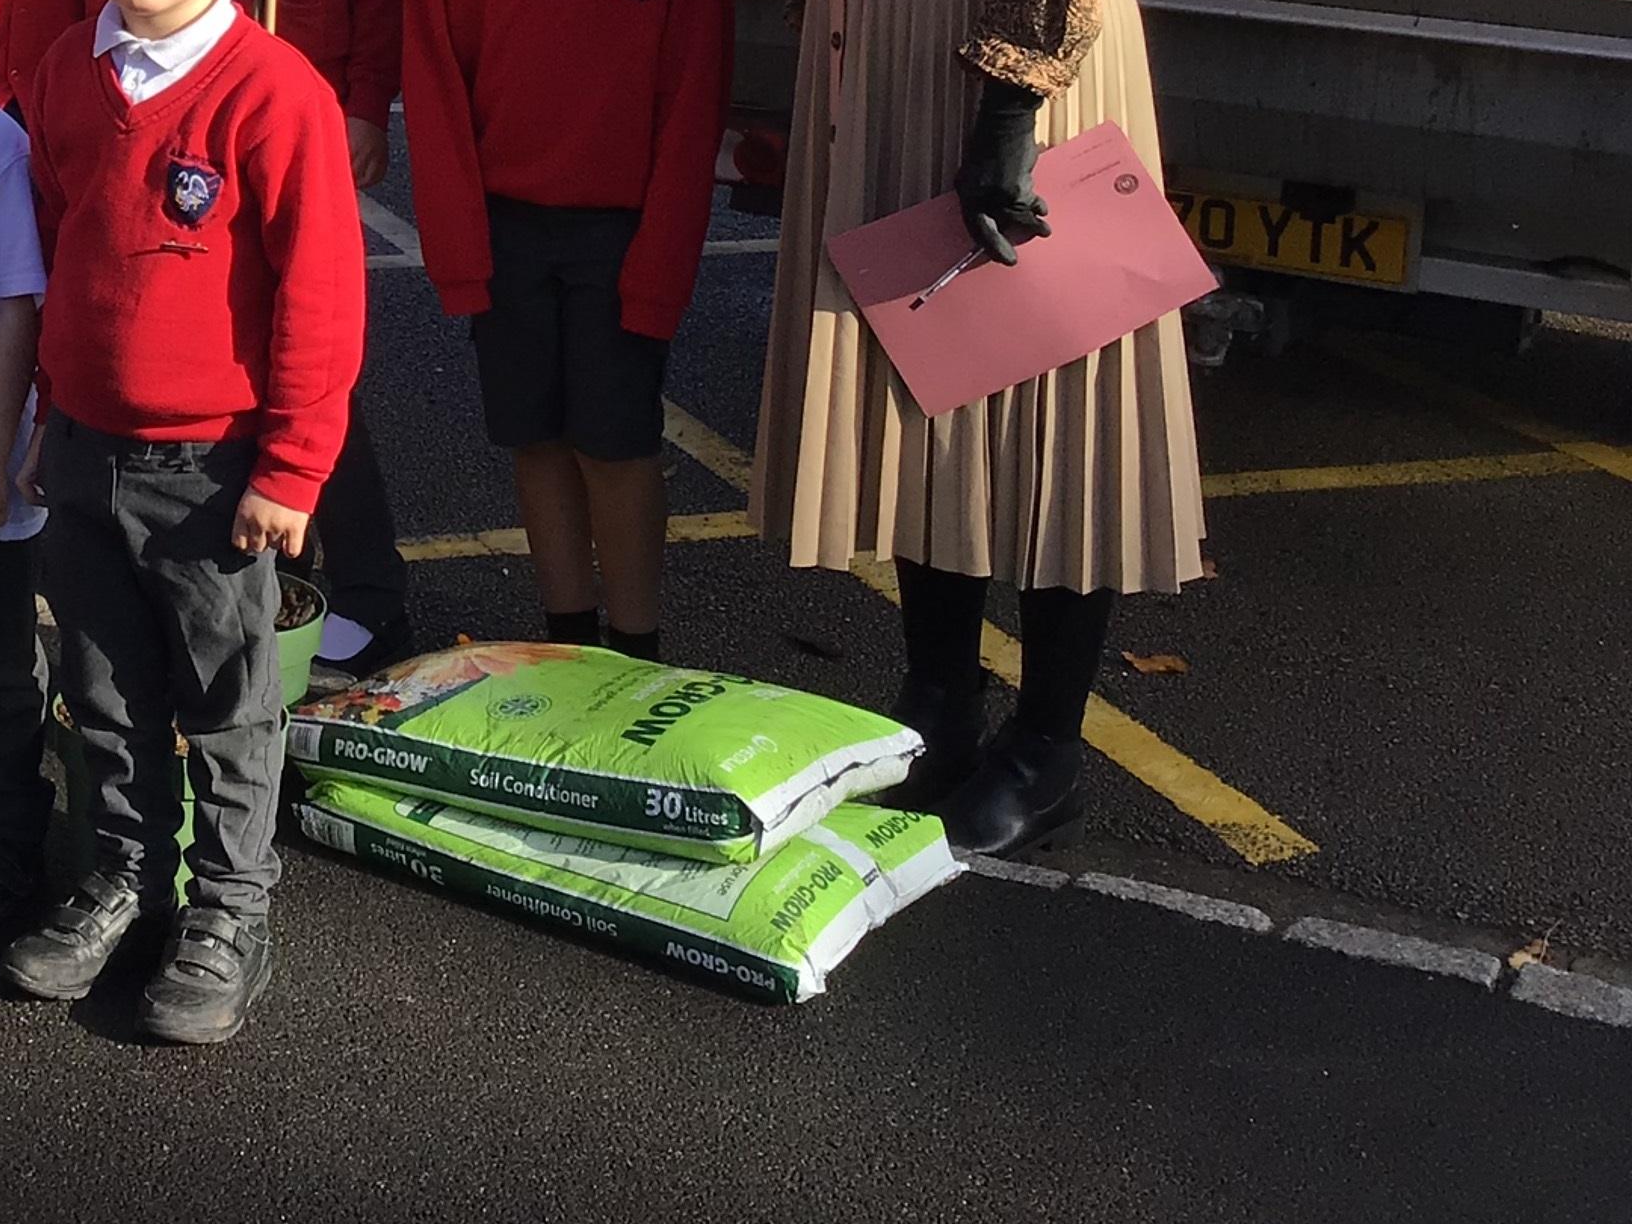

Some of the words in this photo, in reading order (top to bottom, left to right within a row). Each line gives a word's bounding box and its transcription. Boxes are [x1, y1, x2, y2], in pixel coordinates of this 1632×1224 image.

[334, 738, 429, 774] PRO-GROW
[470, 769, 499, 790] Soil
[502, 775, 599, 809] Conditioner
[645, 788, 681, 820] 30
[685, 806, 728, 826] Litres
[865, 810, 926, 848] O-GROW
[370, 843, 407, 866] Litres
[410, 858, 445, 886] 30
[486, 883, 583, 926] Conditioner
[718, 875, 740, 896] use
[770, 860, 843, 933] PRO-GROW
[587, 915, 618, 937] Soil
[666, 941, 776, 991] PRO-GROW
